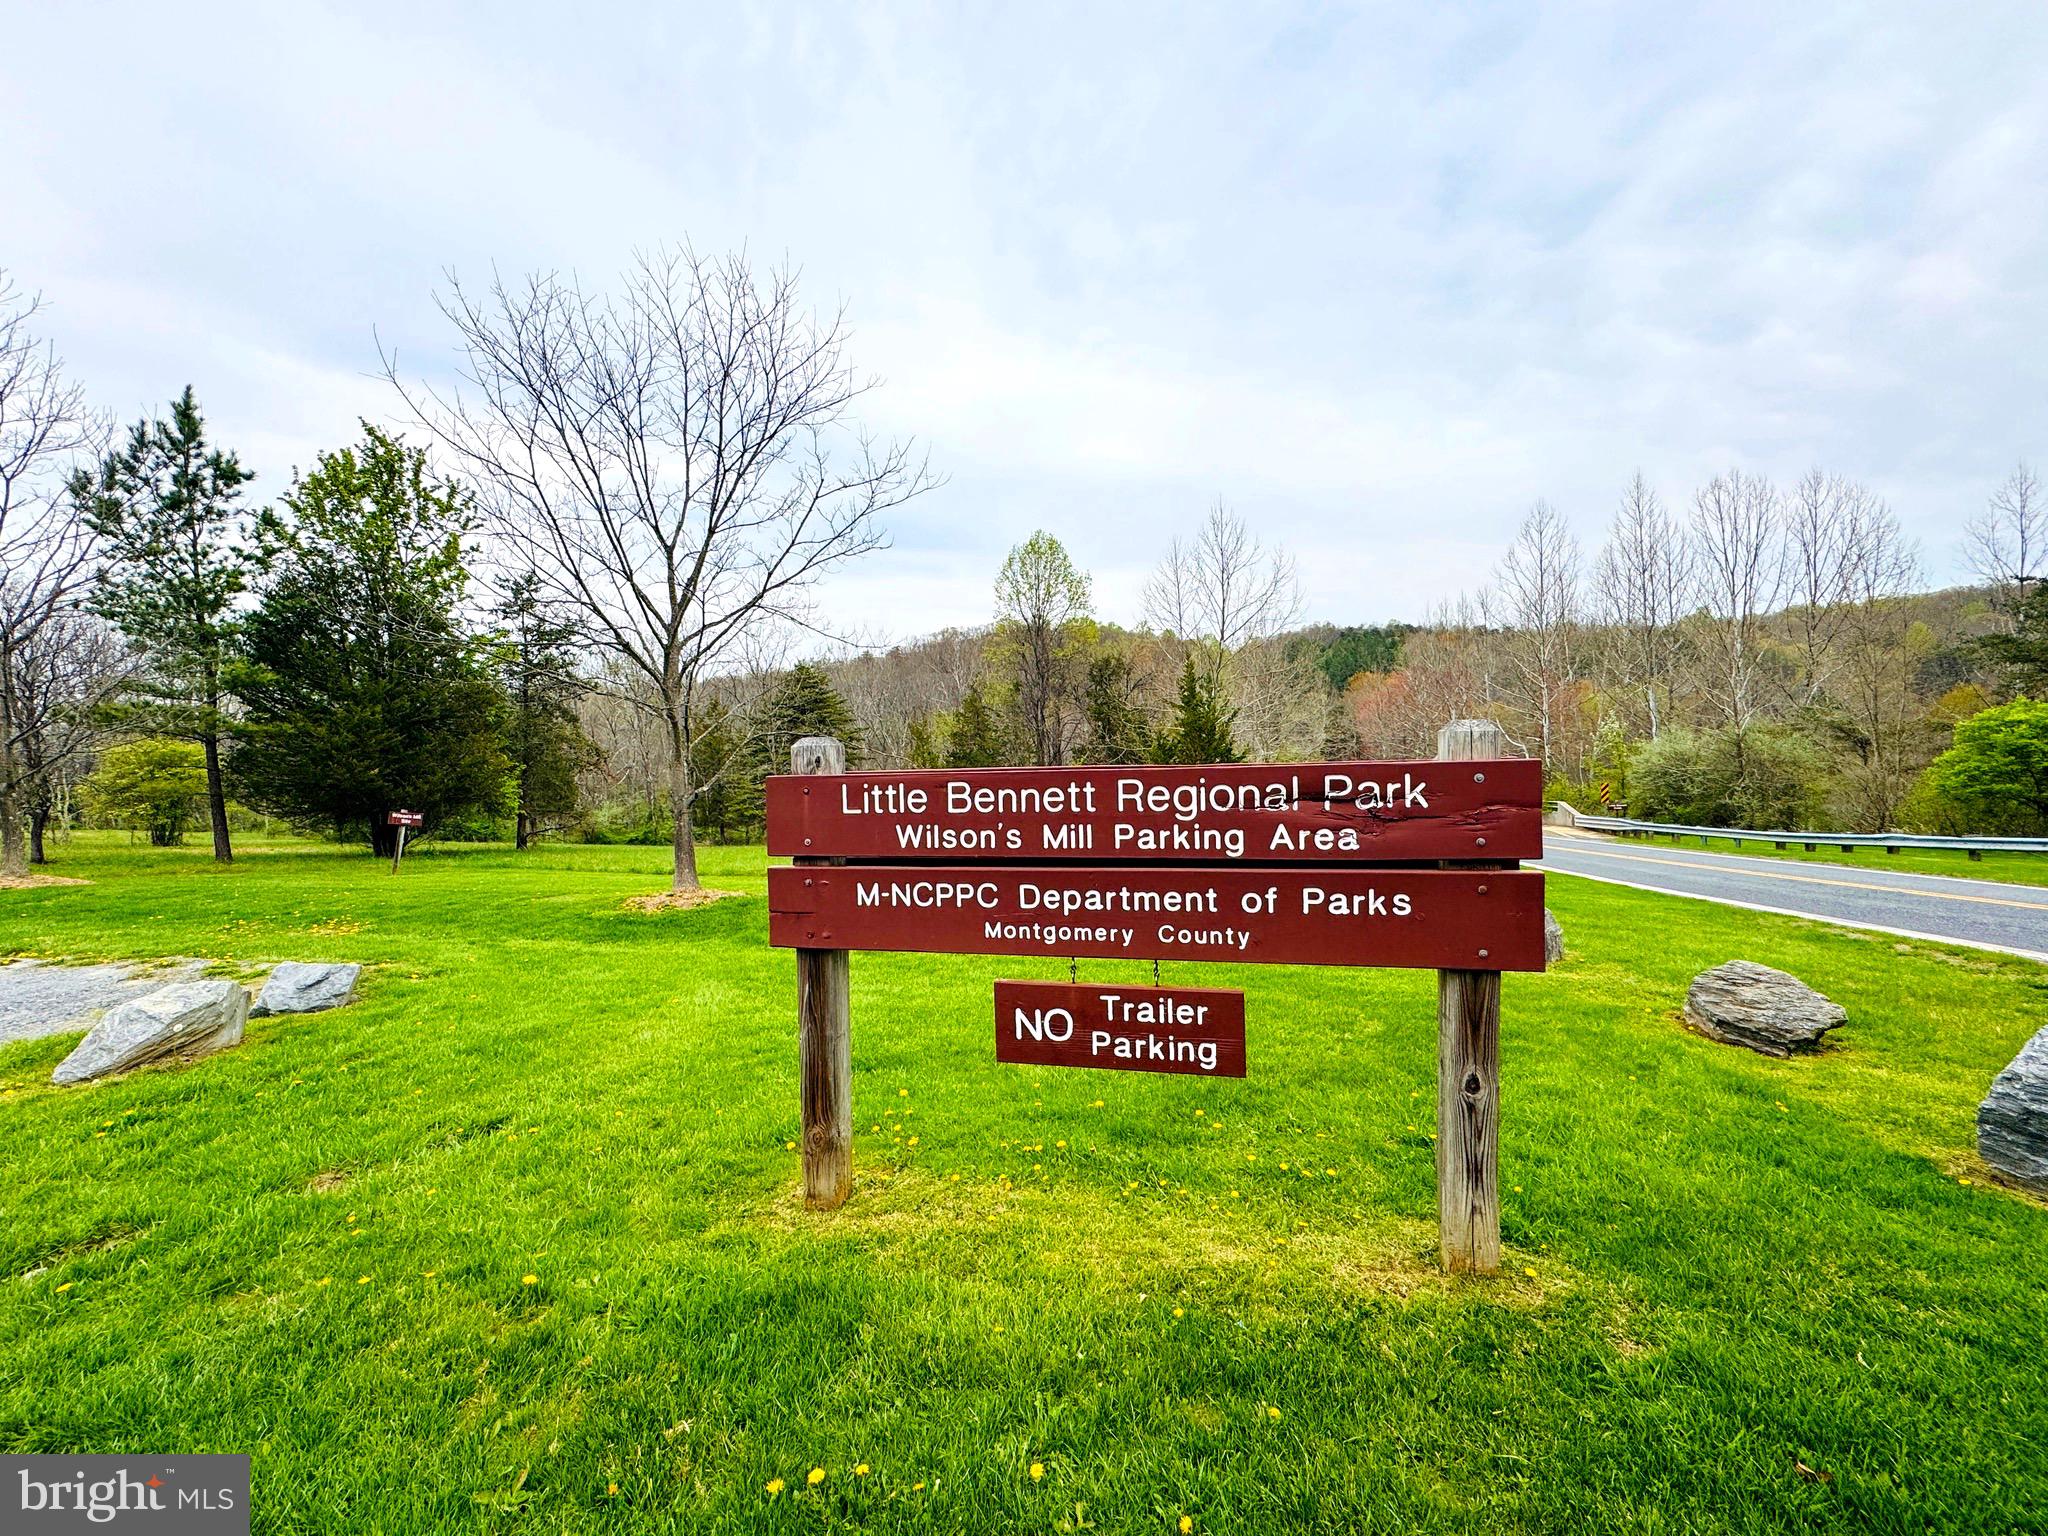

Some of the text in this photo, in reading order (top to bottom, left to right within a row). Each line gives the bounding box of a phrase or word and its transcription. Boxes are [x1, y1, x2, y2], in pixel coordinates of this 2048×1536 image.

[841, 774, 1429, 821] Little Bennett Regional Park
[895, 822, 1361, 858] Wilson's Mill Parking Area
[856, 882, 1412, 916] M-NCPPC Department of Parks
[984, 921, 1250, 950] Montgomery County
[1015, 1007, 1074, 1042] NO
[1099, 995, 1209, 1026] Trailer
[1091, 1030, 1217, 1070] Parking
